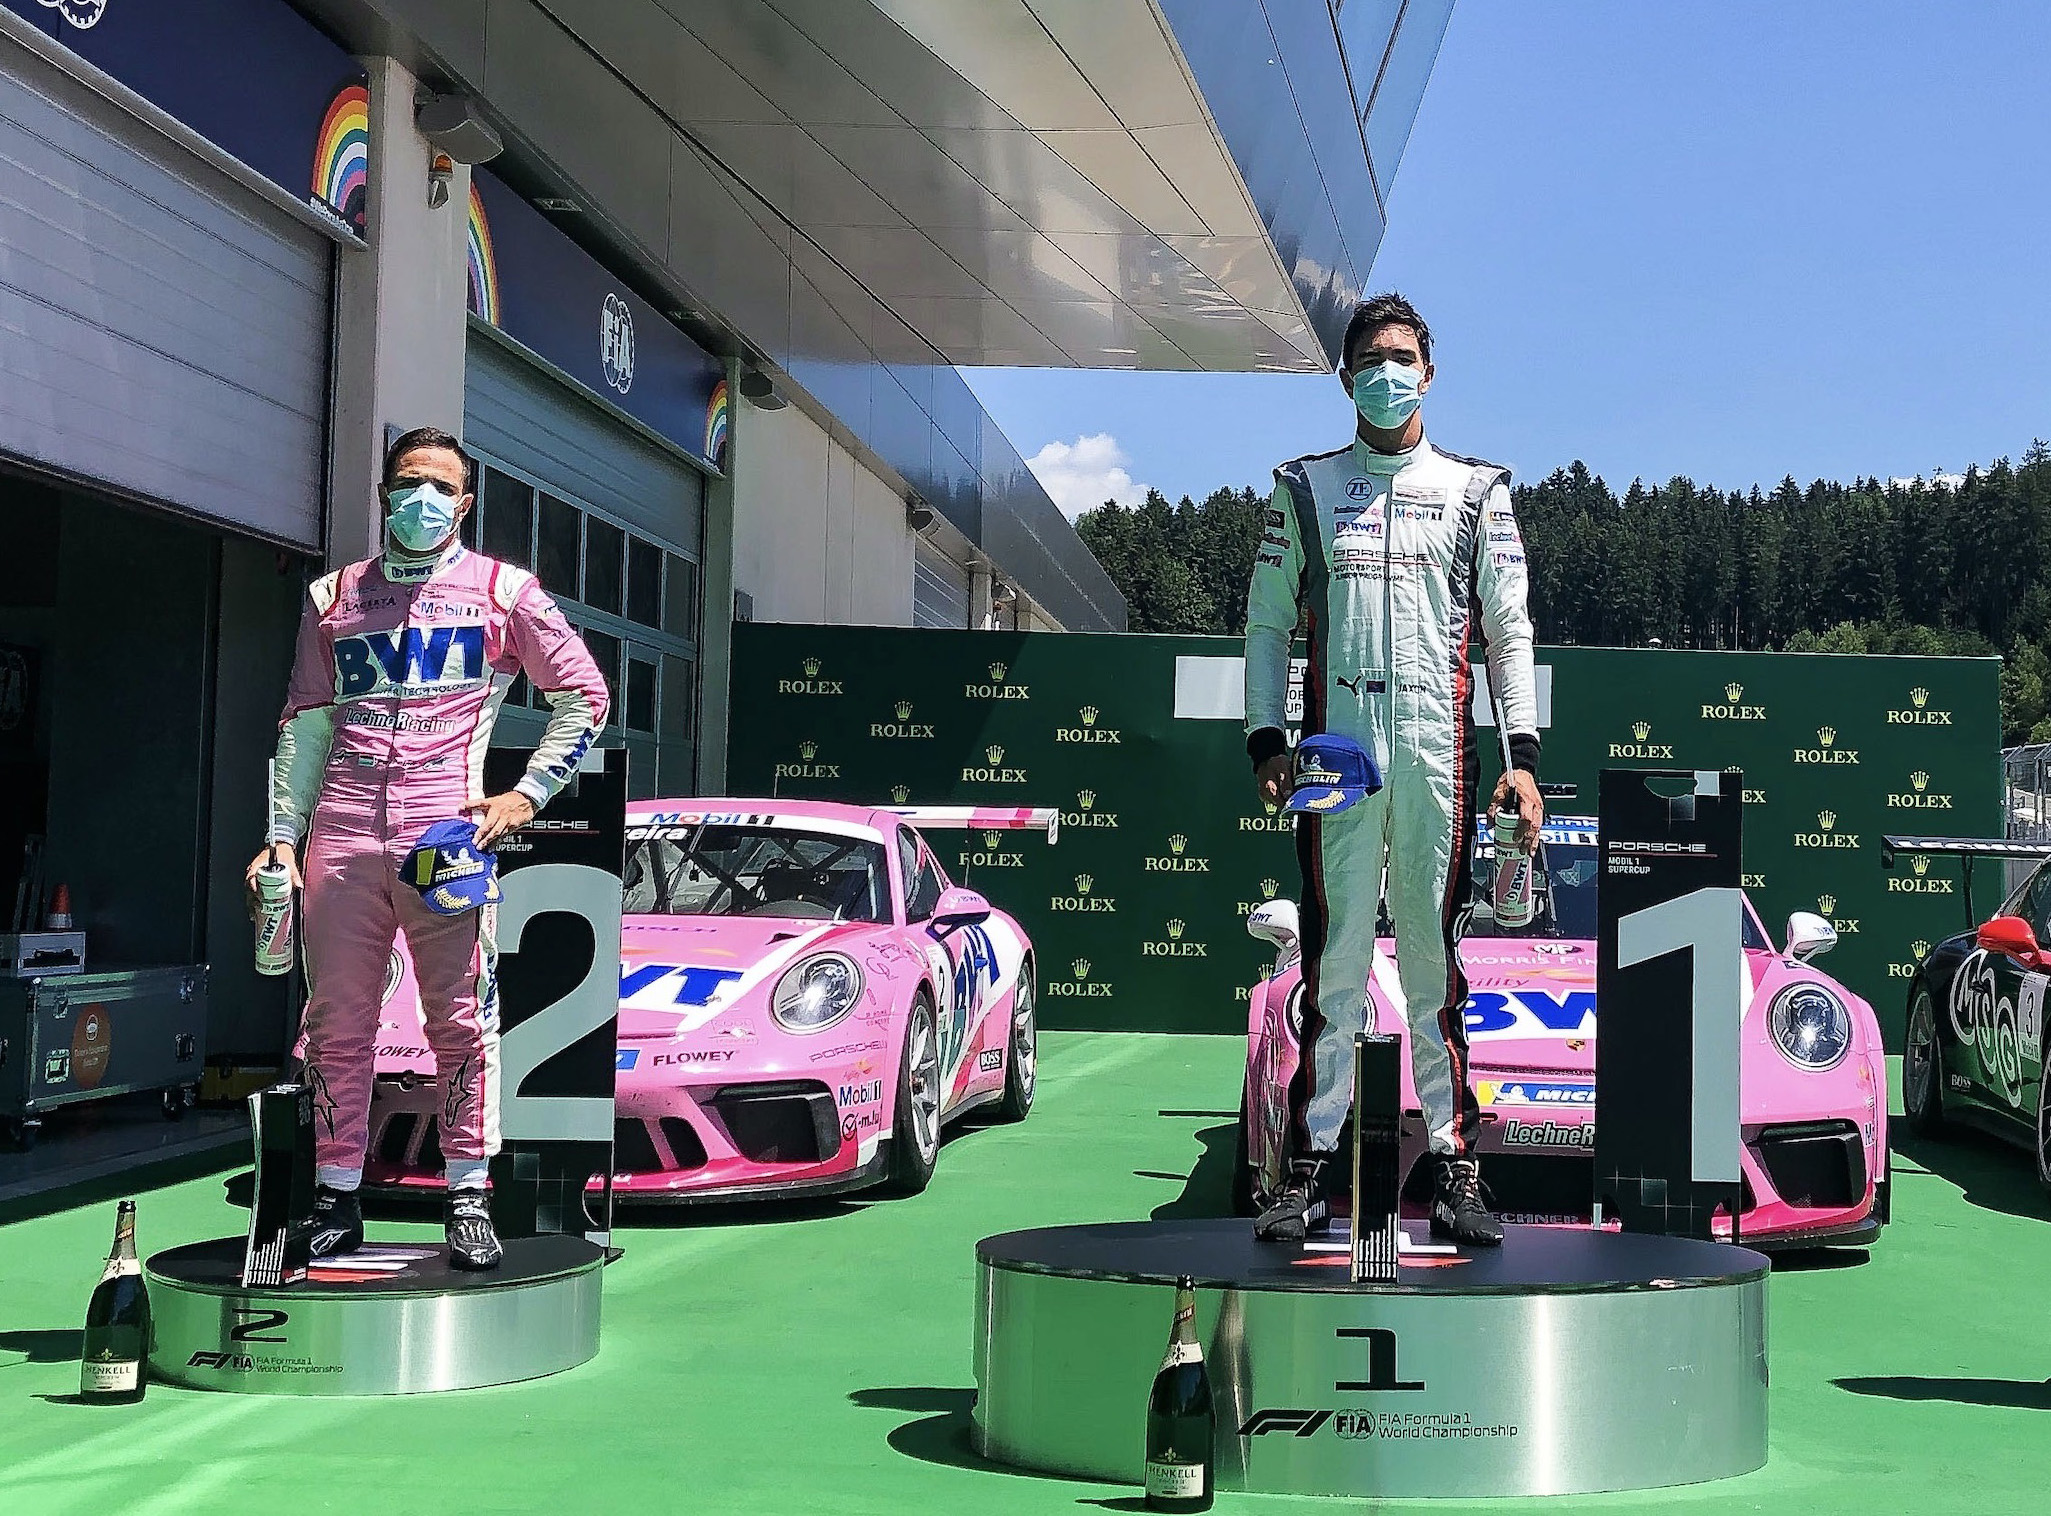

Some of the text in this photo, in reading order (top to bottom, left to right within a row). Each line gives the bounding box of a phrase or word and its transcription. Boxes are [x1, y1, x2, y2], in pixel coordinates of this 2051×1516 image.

[1394, 507, 1429, 520] Mobil
[1333, 549, 1429, 561] PORSCHE
[421, 601, 463, 617] Mobil
[334, 626, 485, 695] BWT
[779, 680, 843, 695] ROLEX
[965, 684, 1030, 699] ROLEX
[1702, 705, 1767, 720] ROLEX
[1887, 711, 1953, 725] ROLEX
[870, 723, 935, 738] ROLEX
[1056, 729, 1121, 744] ROLEX
[1608, 744, 1674, 759] ROLEX
[1794, 750, 1860, 764] ROLEX
[775, 764, 841, 779] ROLEX
[962, 768, 1027, 783] ROLEX
[1887, 794, 1953, 809] ROLEX
[650, 813, 741, 824] Mobil
[496, 844, 533, 852] UPERCUP
[1608, 841, 1706, 853] PORSCHE
[1794, 834, 1860, 849] ROLEX
[1145, 857, 1210, 872] ROLEX
[1635, 857, 1640, 865] 1
[1608, 866, 1651, 875] SUPERCUP
[1887, 878, 1954, 893] ROLEX
[1051, 897, 1116, 912] ROLEX
[1143, 942, 1208, 957] ROLEX
[1048, 982, 1113, 997] ROLEX
[497, 864, 623, 1140] 2
[2026, 991, 2034, 1039] 3
[1618, 887, 1742, 1182] 1
[653, 1050, 734, 1067] FLOWEY
[809, 1040, 878, 1063] PORSCHE
[840, 1082, 873, 1107] Mobil
[1492, 1212, 1579, 1223] ECHNER
[231, 1308, 289, 1342] 2
[232, 1356, 252, 1369] FIA
[1335, 1328, 1425, 1391] 1
[282, 1366, 344, 1374] Championship
[1336, 1415, 1372, 1434] FIA
[1379, 1413, 1401, 1425] FIA
[1404, 1413, 1461, 1426] Formula
[1464, 1412, 1471, 1424] 1
[1379, 1425, 1518, 1440] World Championship
